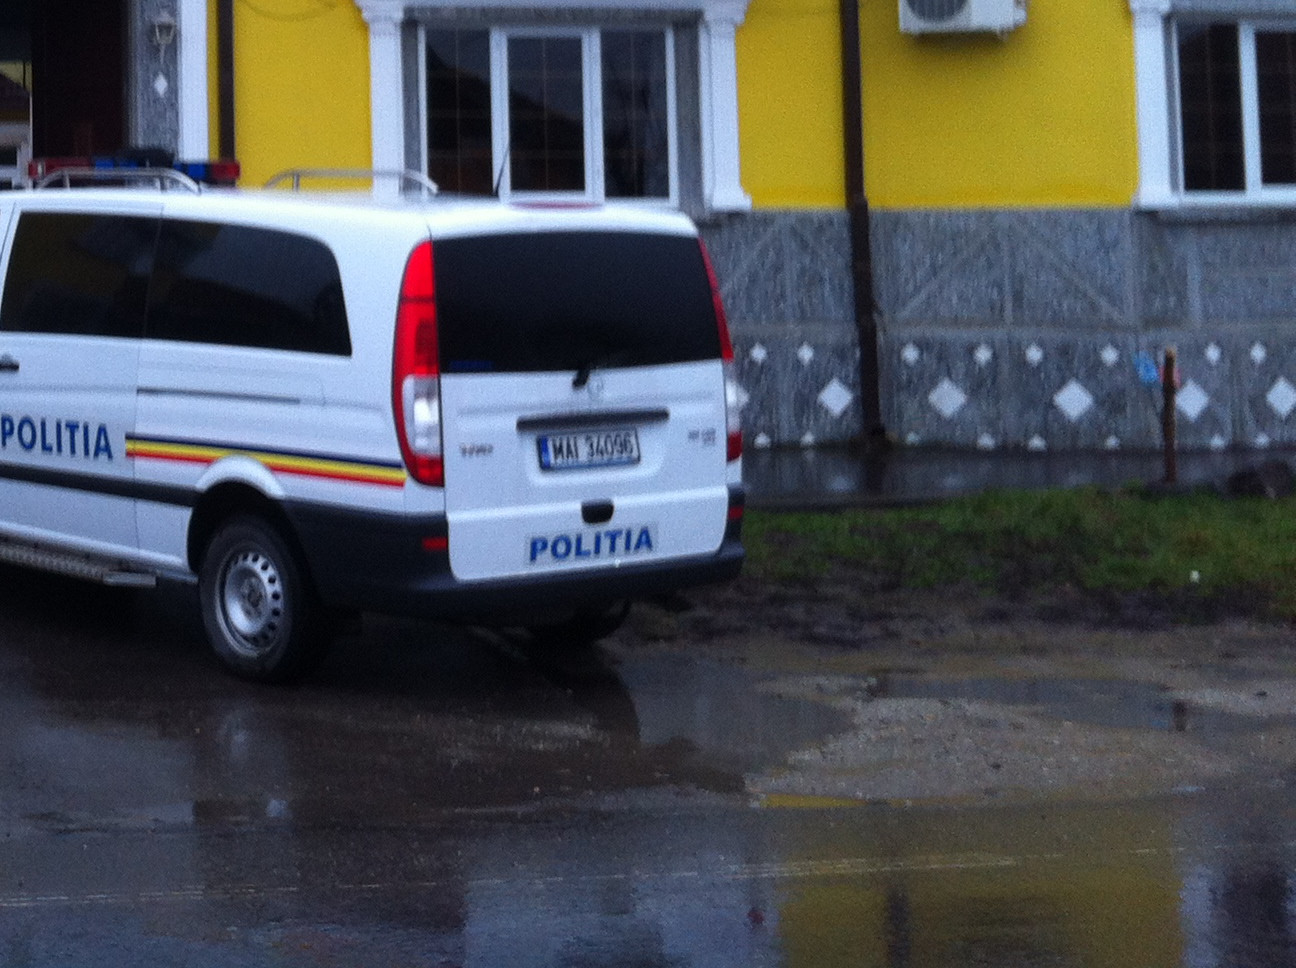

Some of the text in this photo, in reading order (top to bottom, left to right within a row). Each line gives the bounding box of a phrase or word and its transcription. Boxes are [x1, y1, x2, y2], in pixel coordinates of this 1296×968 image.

[0, 414, 114, 462] POLITIA
[552, 435, 579, 461] MAI
[529, 526, 653, 563] POLITIA
